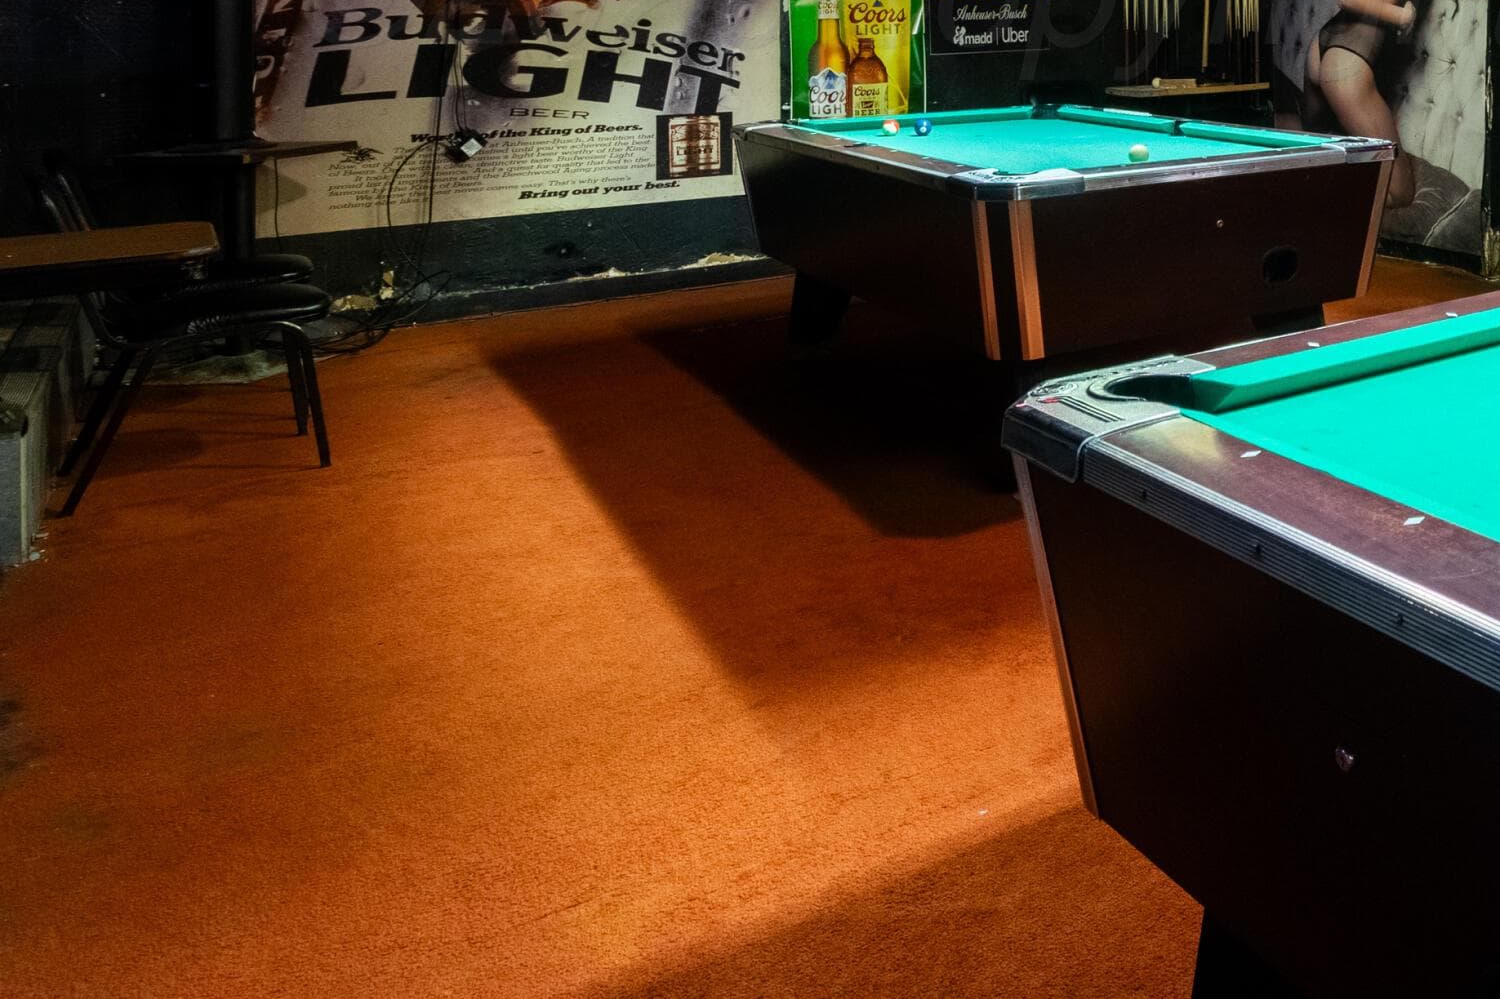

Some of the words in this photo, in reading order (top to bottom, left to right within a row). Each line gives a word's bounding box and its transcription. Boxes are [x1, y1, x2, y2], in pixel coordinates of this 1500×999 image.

[848, 2, 906, 24] Coors
[953, 3, 1029, 21] Anheuser-Busch
[856, 24, 901, 36] LIGHT
[965, 31, 993, 45] madd
[1002, 26, 1029, 43] Uber
[312, 6, 746, 79] Budweiser
[305, 40, 740, 116] LIGHT
[809, 85, 847, 104] Coor
[854, 86, 880, 98] Coors
[509, 107, 590, 120] BEER
[811, 104, 844, 116] LIGH
[499, 128, 527, 138] the
[529, 126, 573, 137] King
[574, 124, 593, 134] of
[594, 123, 643, 133] Beers.
[518, 188, 570, 199] Bring
[571, 186, 600, 195] out
[602, 184, 642, 195] your
[644, 180, 681, 190] best.
